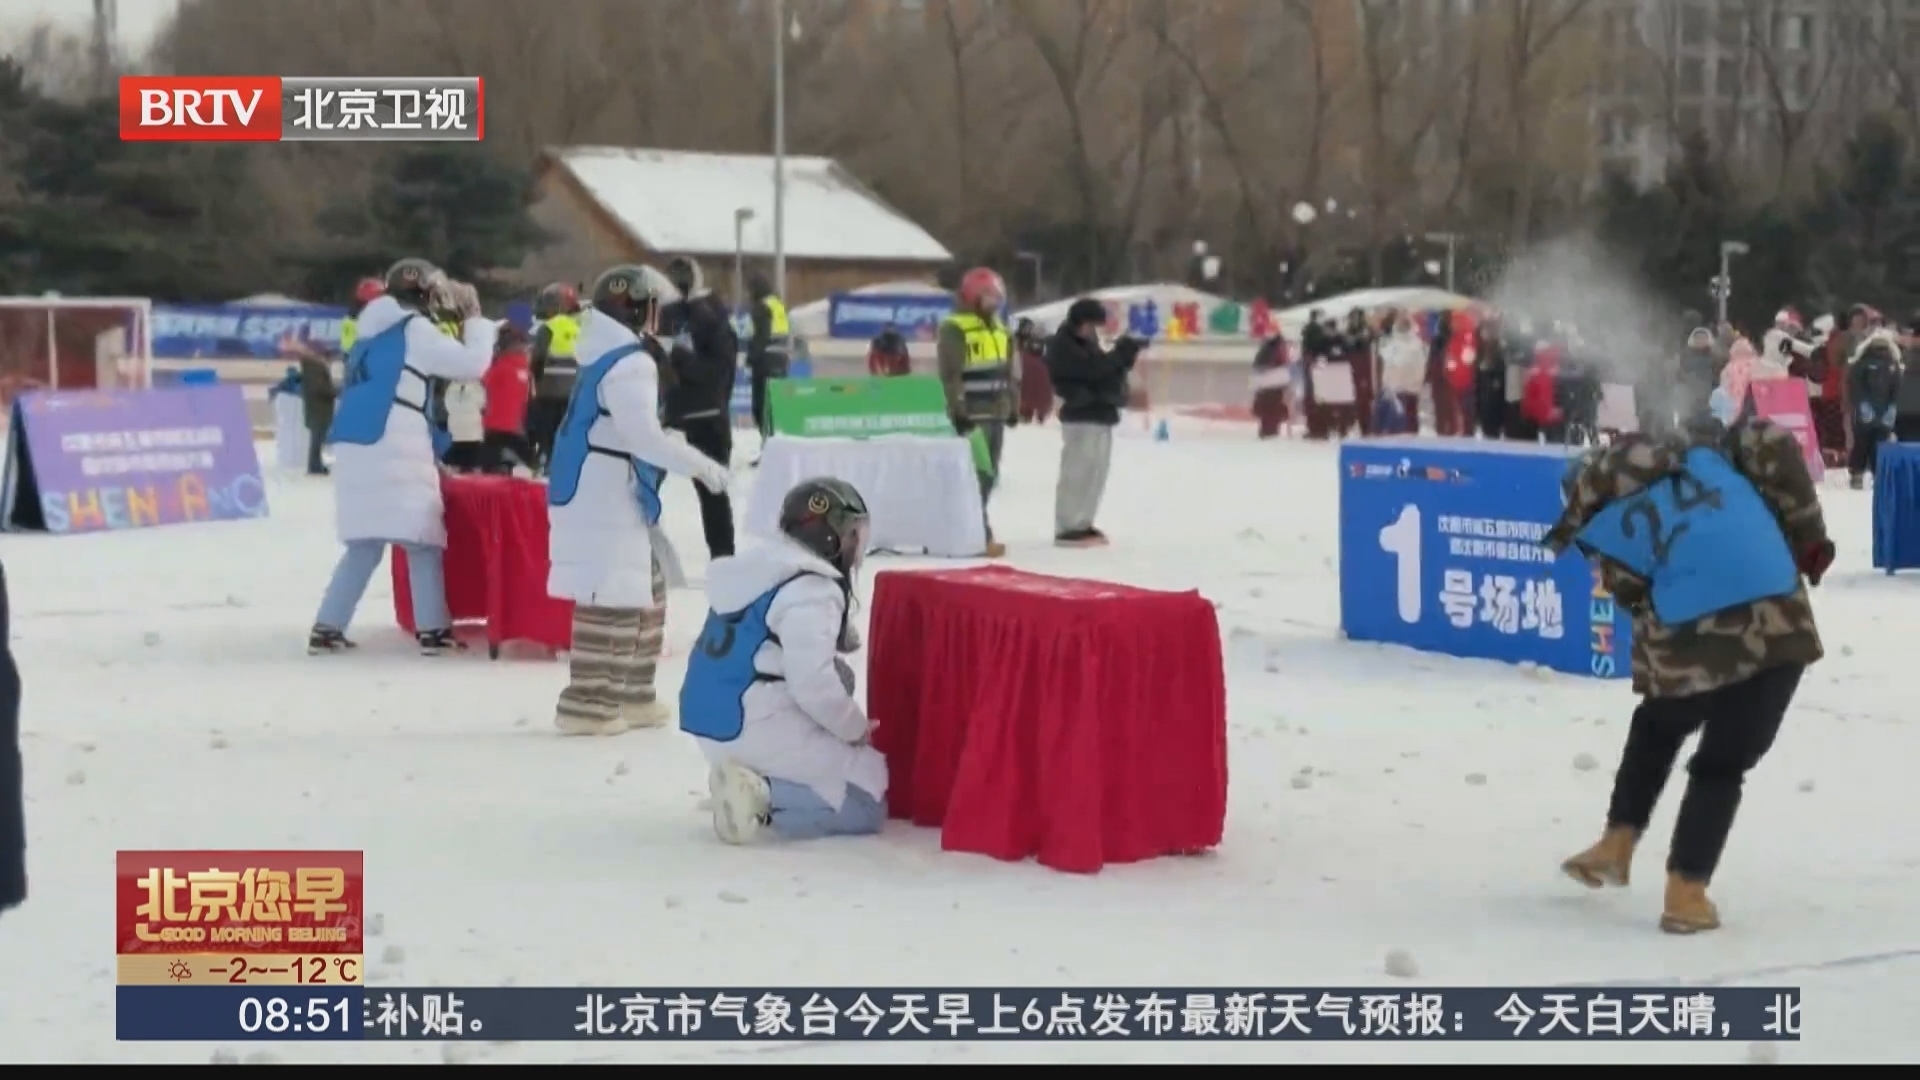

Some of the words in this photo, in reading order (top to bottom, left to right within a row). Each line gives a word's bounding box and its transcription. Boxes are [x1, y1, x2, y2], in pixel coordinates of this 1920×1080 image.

[1379, 503, 1421, 624] 1
[1438, 570, 1565, 640] 号场地
[1620, 471, 1725, 568] 24
